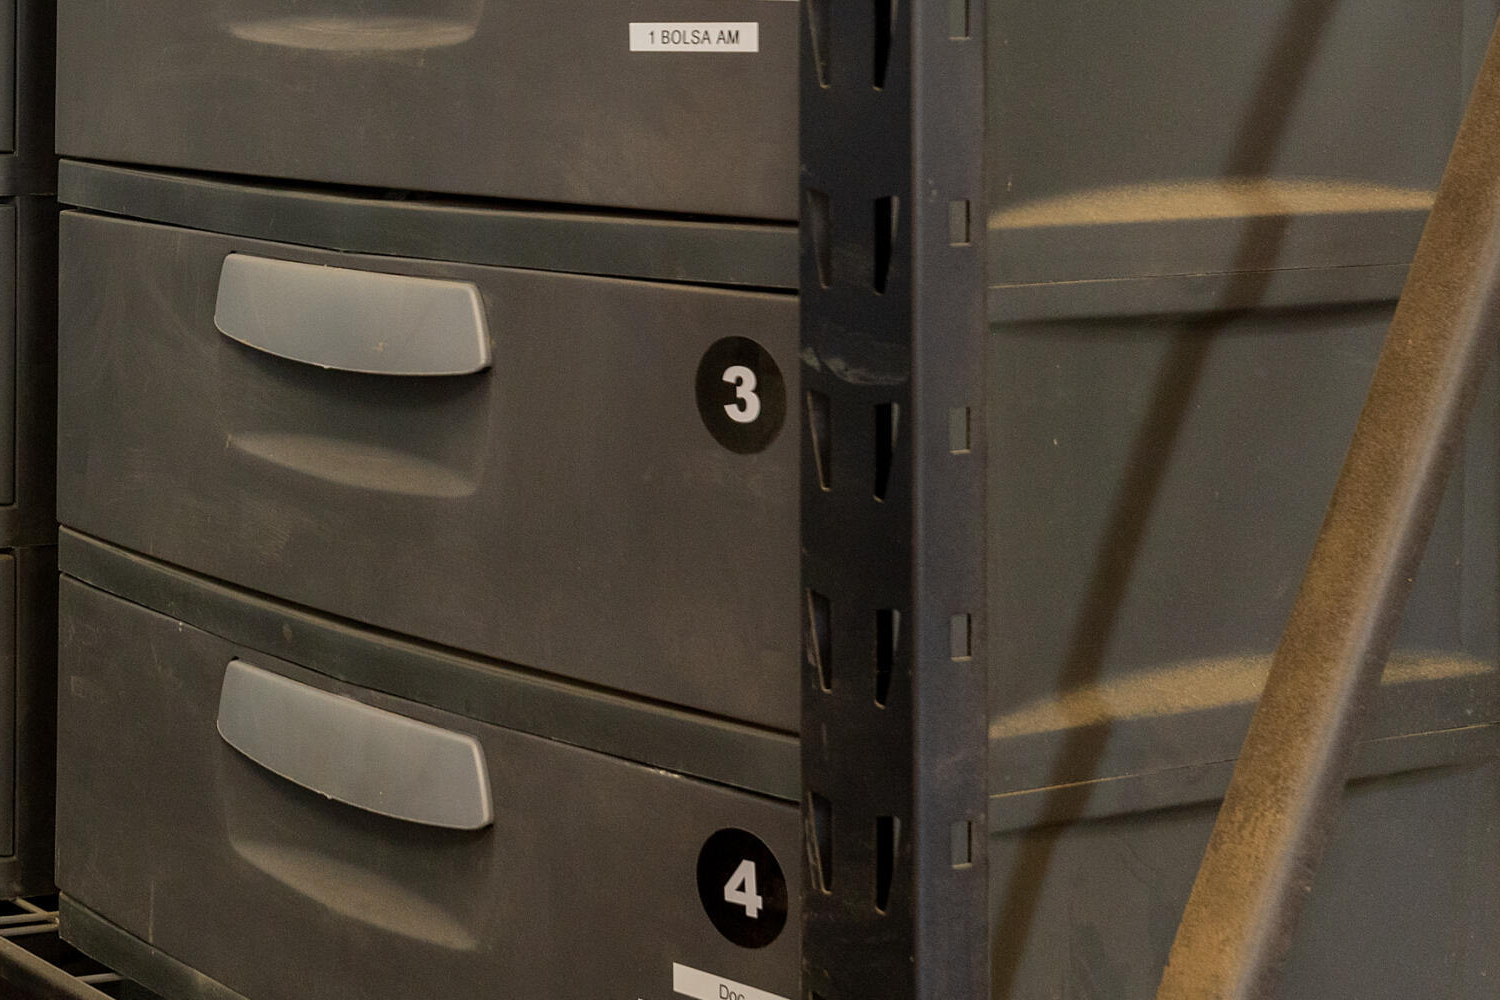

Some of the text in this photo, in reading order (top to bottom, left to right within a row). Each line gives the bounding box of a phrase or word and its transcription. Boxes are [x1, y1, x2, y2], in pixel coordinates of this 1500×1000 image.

[648, 29, 740, 45] 1 BOLSA AM
[722, 365, 762, 424] 3
[723, 858, 763, 919] 4
